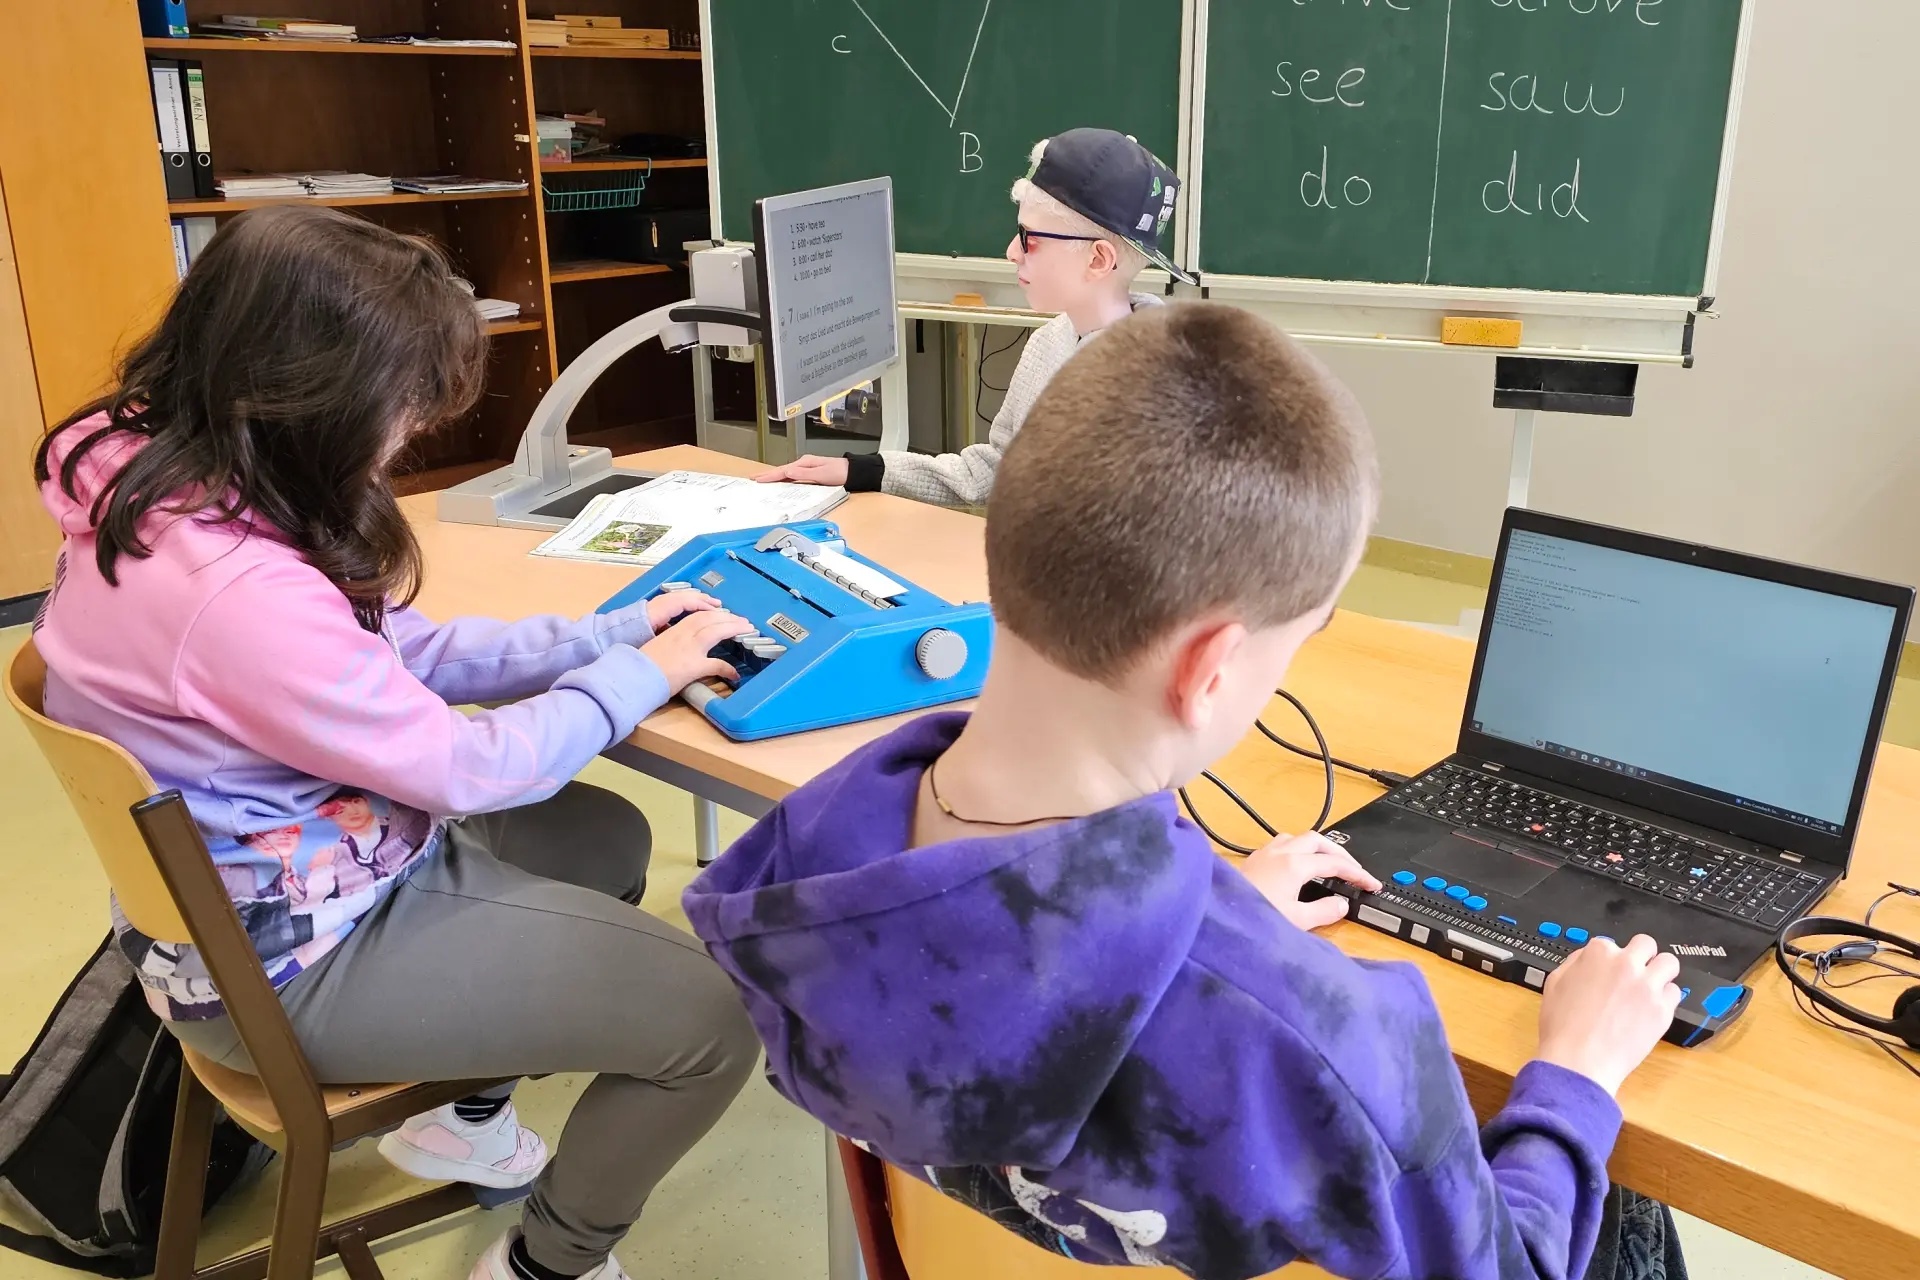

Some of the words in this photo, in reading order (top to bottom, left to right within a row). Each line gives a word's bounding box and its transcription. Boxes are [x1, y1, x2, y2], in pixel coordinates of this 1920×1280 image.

[1271, 61, 1366, 107] see
[1480, 71, 1625, 117] saw
[192, 95, 204, 121] AMEN
[170, 96, 182, 148] Vertretungsordner
[960, 132, 983, 172] B
[1300, 145, 1372, 209] do
[1482, 150, 1590, 223] did
[808, 220, 818, 230] have
[810, 236, 820, 246] watch
[813, 268, 819, 280] go
[788, 306, 794, 324] 7
[821, 302, 834, 316] going
[798, 334, 810, 346] Singt
[818, 328, 826, 338] Lied
[1669, 944, 1728, 957] ThinkPad
